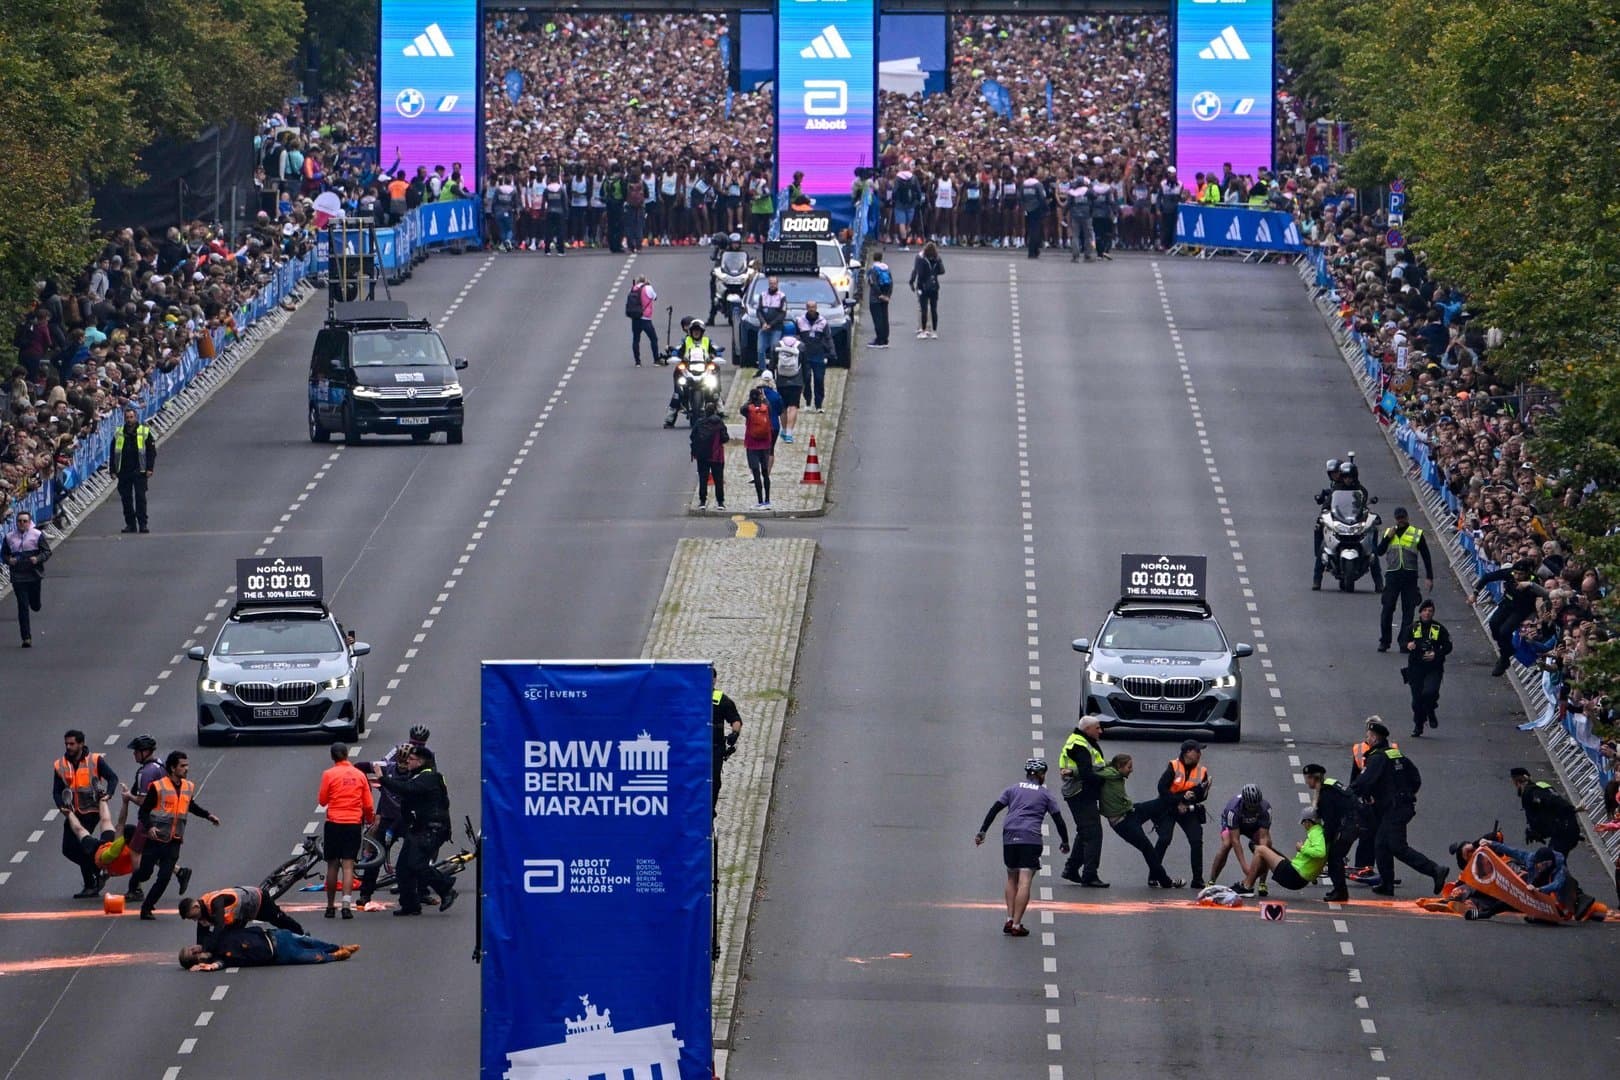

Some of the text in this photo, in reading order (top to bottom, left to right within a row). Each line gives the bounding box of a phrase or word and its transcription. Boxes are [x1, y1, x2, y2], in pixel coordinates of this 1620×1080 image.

[805, 119, 847, 130] Abbott
[1391, 195, 1400, 212] P
[783, 217, 829, 231] 0:00:00
[1141, 563, 1186, 571] NORQAIN
[523, 689, 588, 700] SCC EVENTS
[1144, 703, 1158, 711] THE
[525, 741, 613, 768] BMW
[525, 772, 613, 792] BERLIN
[1019, 782, 1039, 791] TEAM
[525, 796, 668, 816] MARATHON
[570, 859, 610, 867] ABBOTT
[570, 867, 607, 876] WORLD
[570, 876, 631, 884] MARATHON
[570, 885, 613, 893] MAJORS
